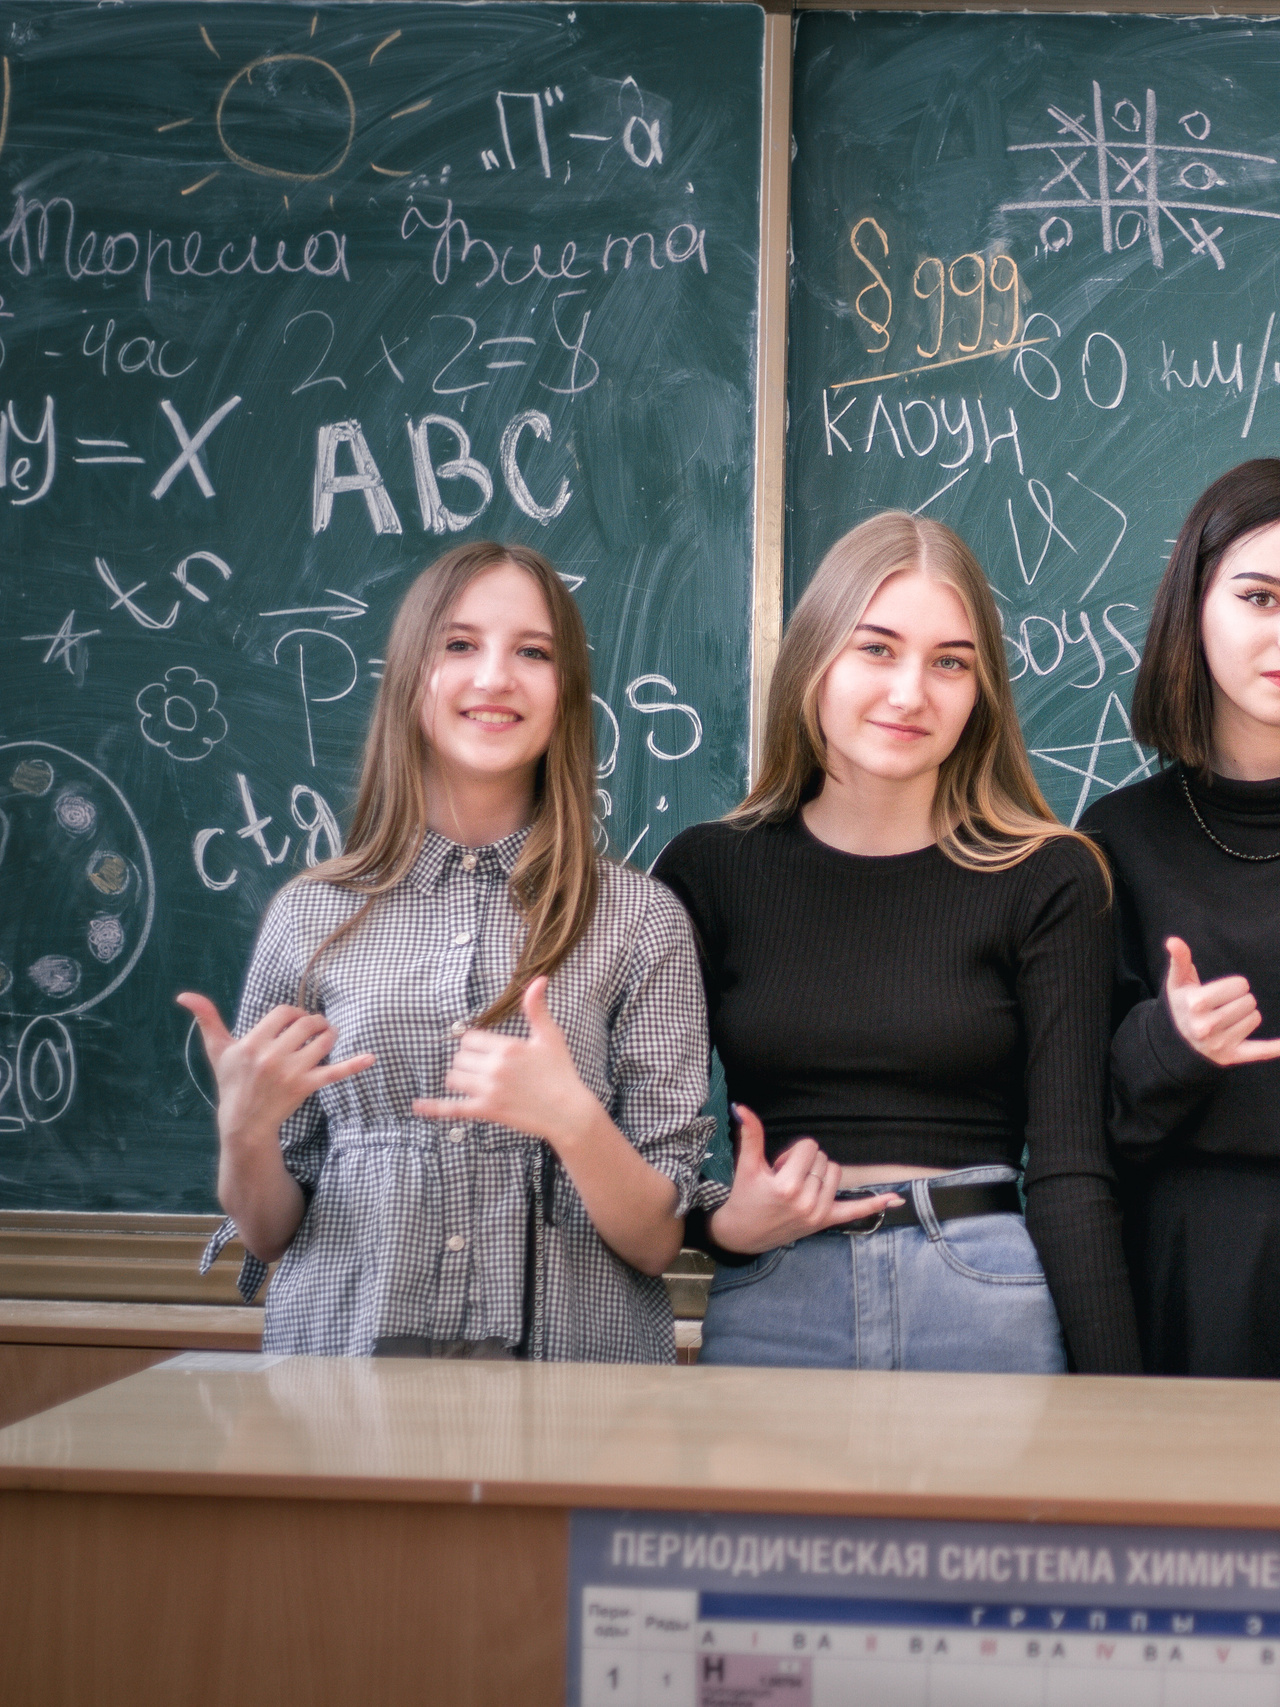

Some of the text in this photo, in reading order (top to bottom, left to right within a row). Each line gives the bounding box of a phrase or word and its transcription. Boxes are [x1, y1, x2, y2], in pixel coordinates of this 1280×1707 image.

[611, 1530, 929, 1579] ПЕРИОДИЧЕСКАЯ
[938, 1544, 1115, 1584] СИСТЕМА
[607, 1665, 620, 1690] 1
